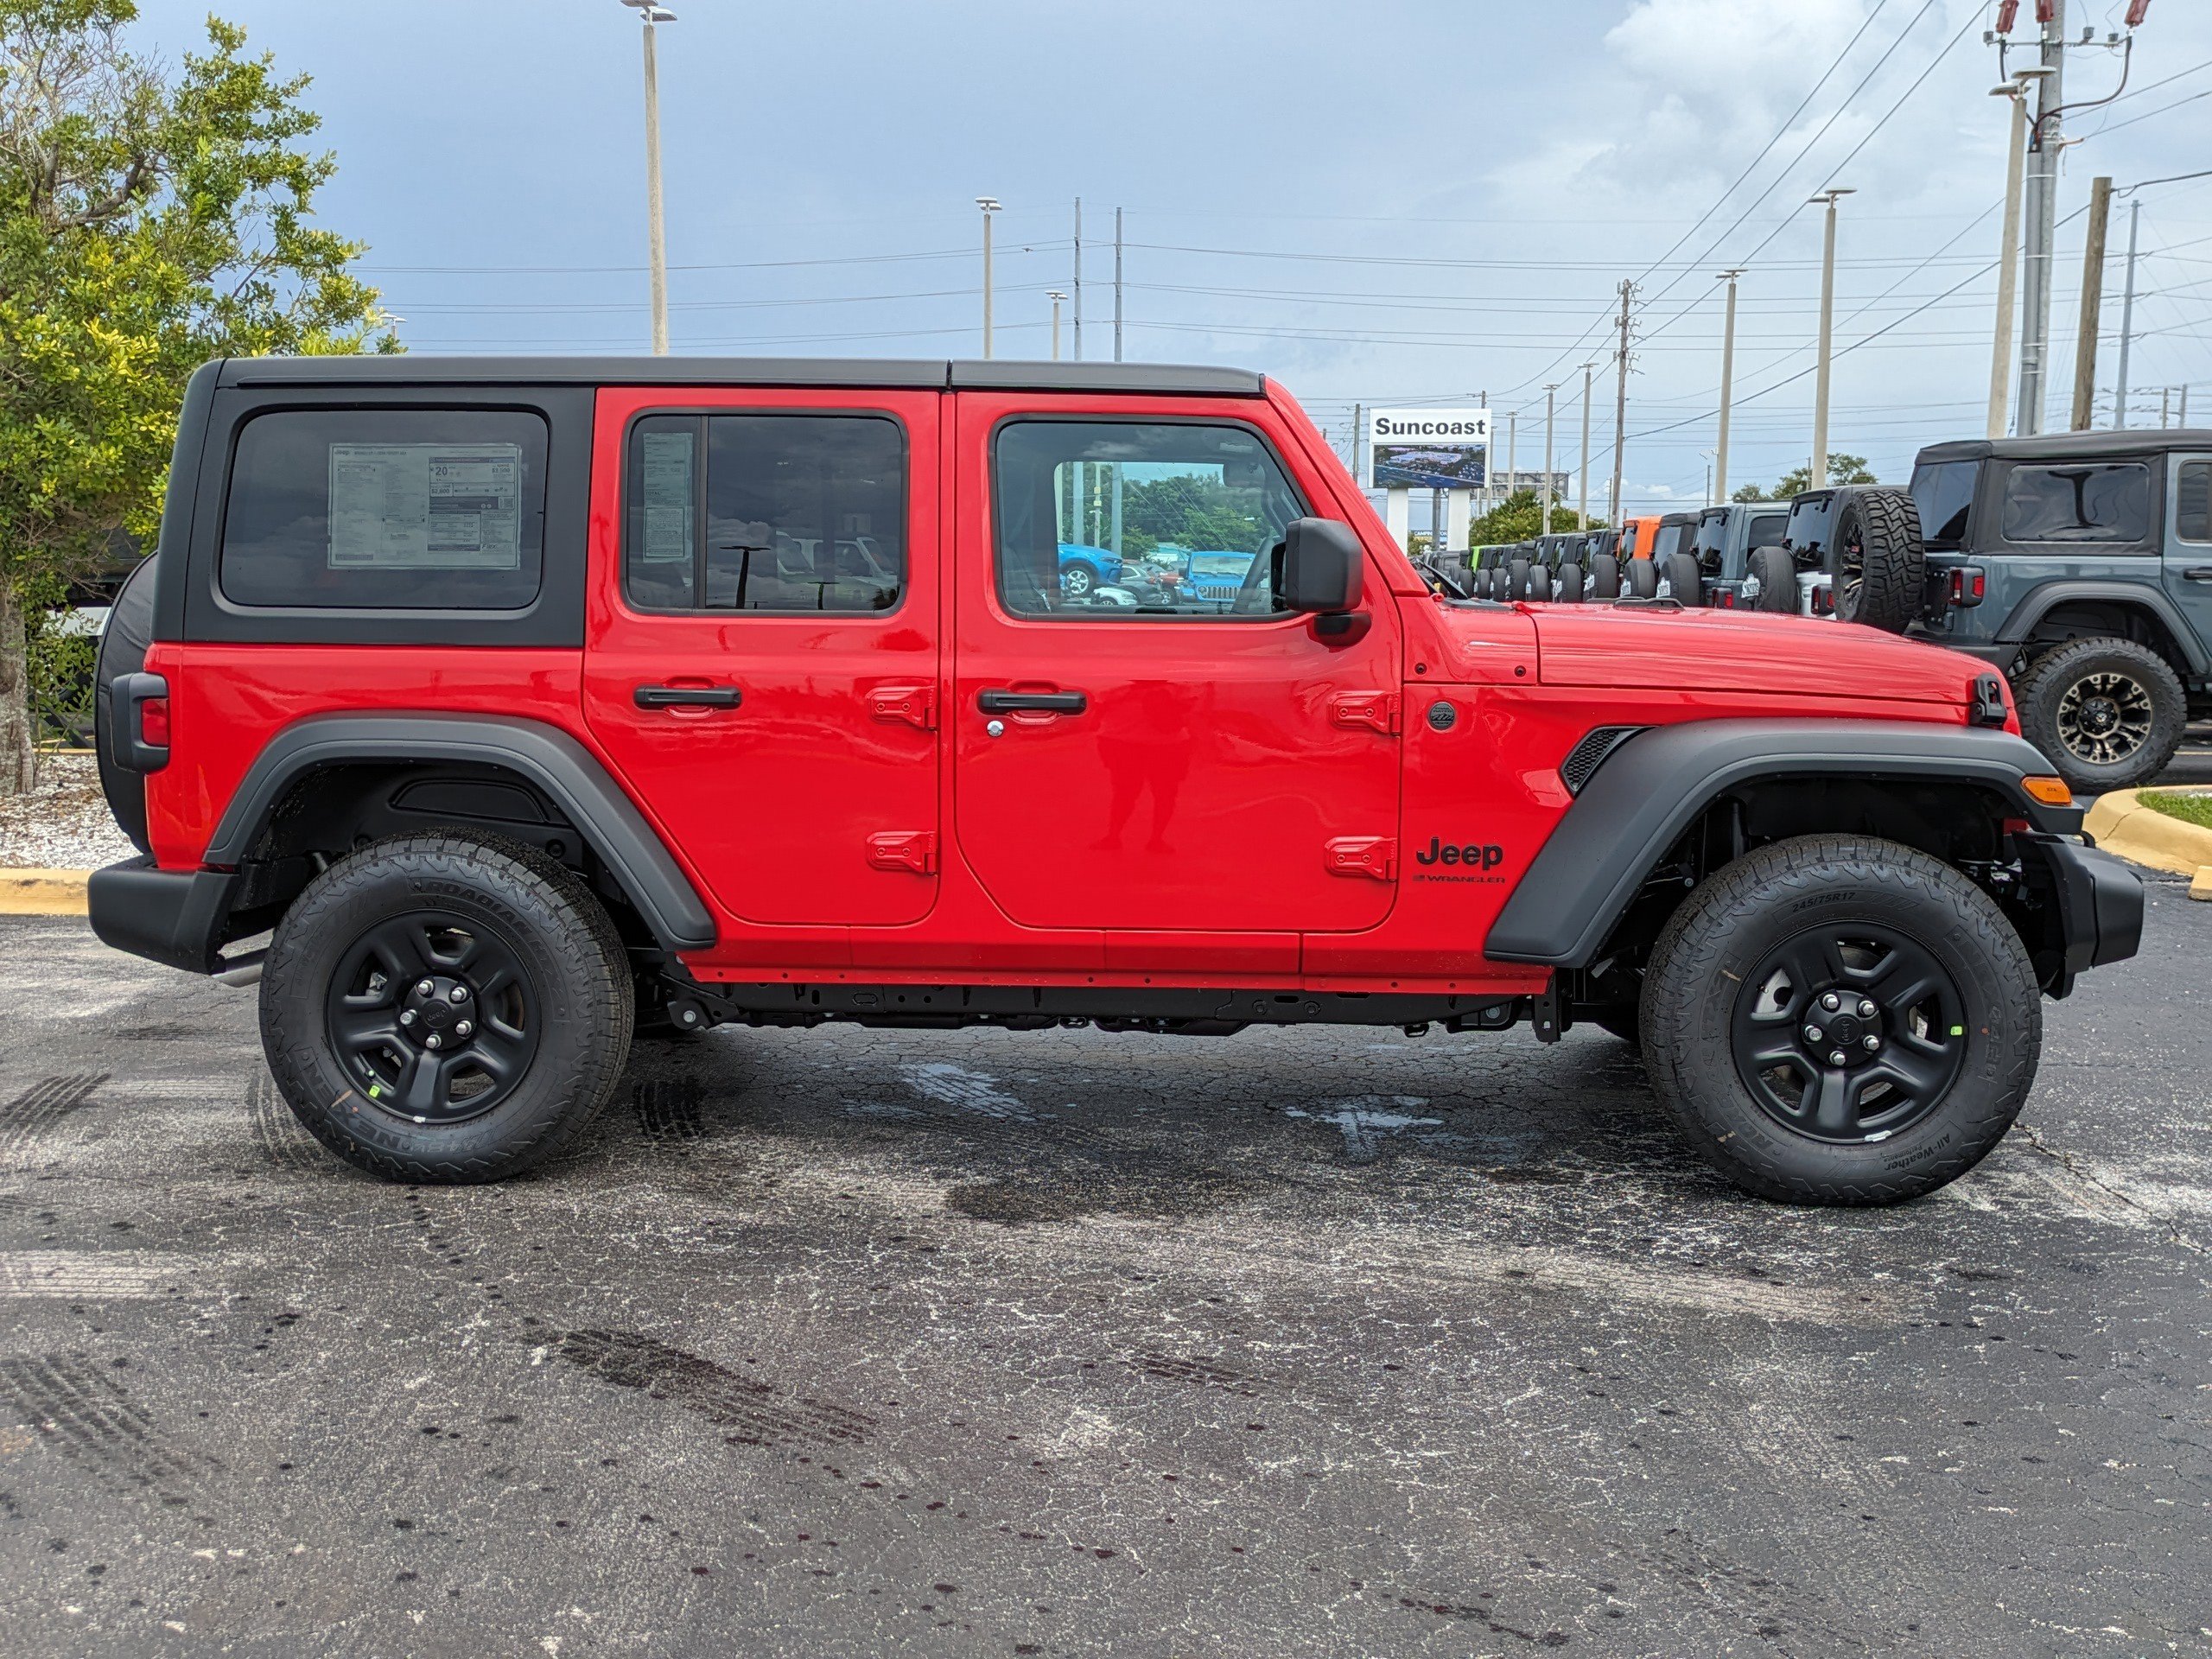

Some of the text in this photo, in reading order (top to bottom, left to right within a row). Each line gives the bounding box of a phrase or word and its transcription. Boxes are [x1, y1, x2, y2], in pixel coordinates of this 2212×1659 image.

[1375, 417, 1486, 435] Suncoast
[435, 467, 448, 476] 20
[1416, 836, 1503, 871] Jeep
[1427, 874, 1506, 884] WRANGLER
[1792, 892, 1857, 913] 245/75R17
[303, 1061, 402, 1150] NEXEN
[1885, 1133, 1950, 1171] All-Weather
